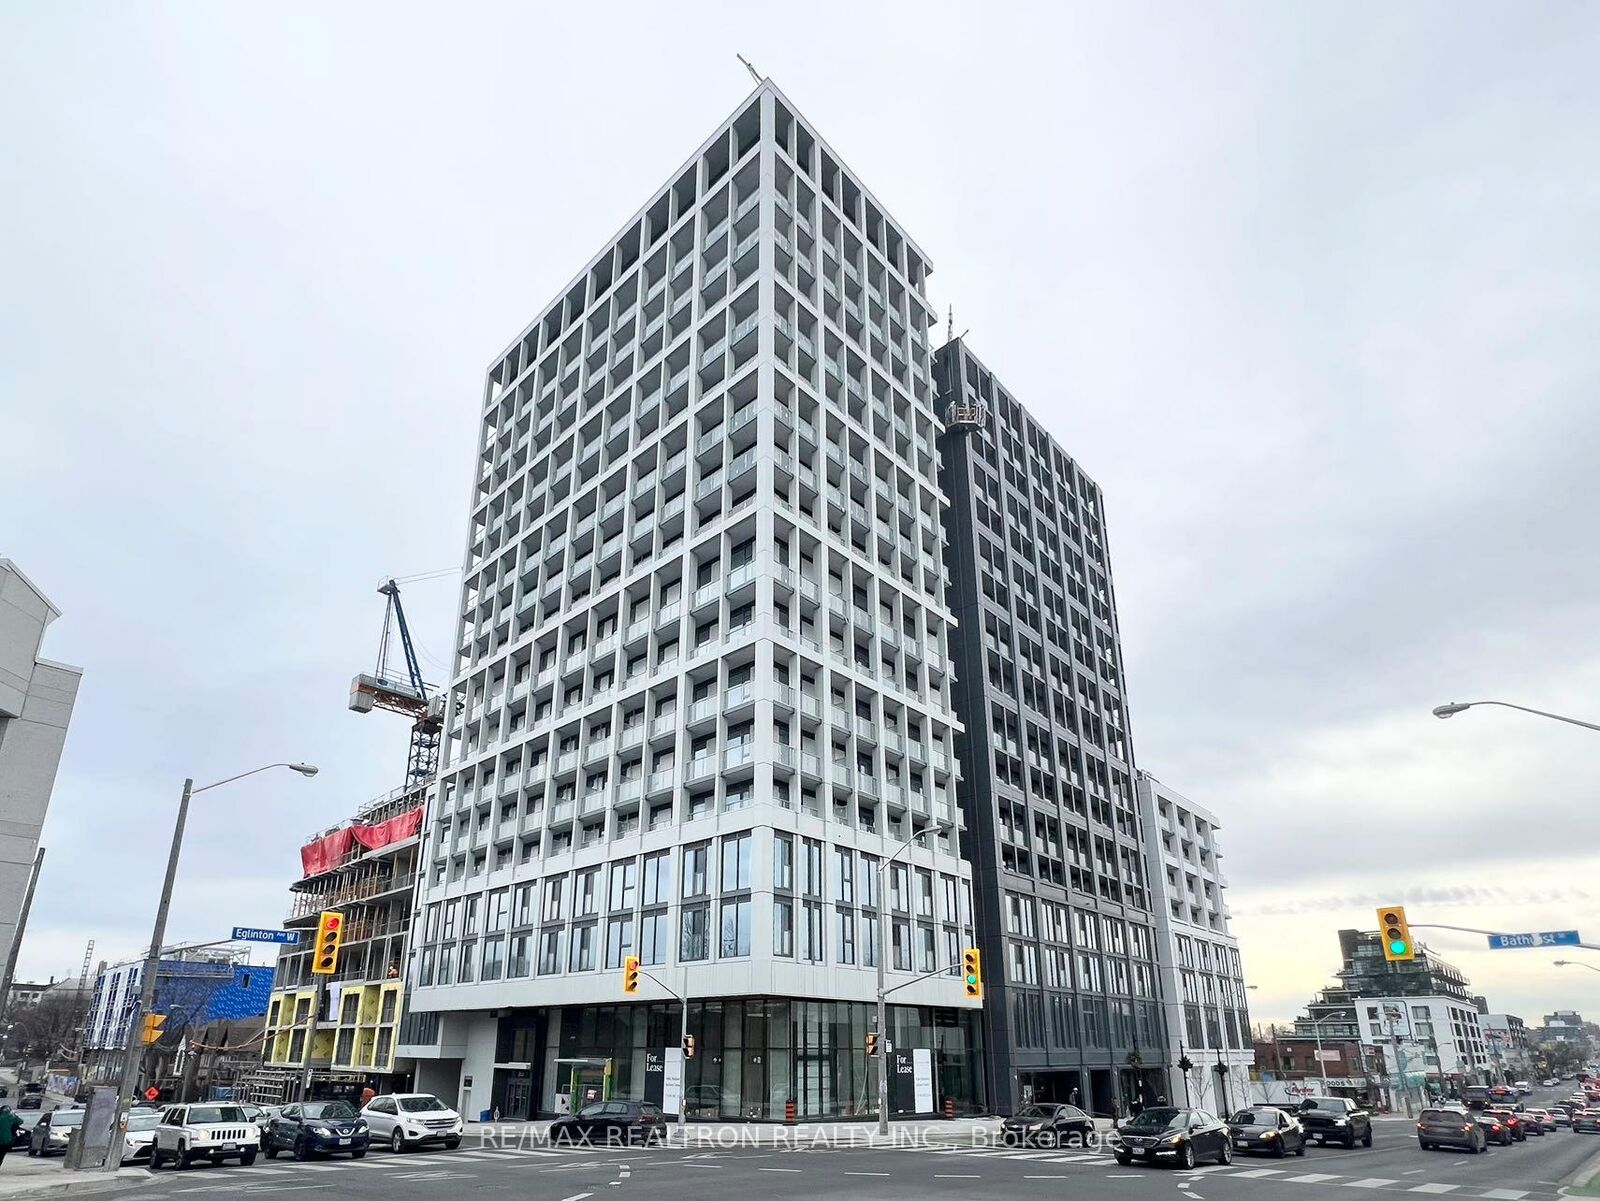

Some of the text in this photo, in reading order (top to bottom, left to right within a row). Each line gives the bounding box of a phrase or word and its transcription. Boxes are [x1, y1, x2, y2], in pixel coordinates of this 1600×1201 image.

[235, 928, 274, 940] Eglinton
[286, 932, 295, 941] W
[1500, 934, 1556, 946] Bathust
[646, 1053, 657, 1063] For
[896, 1054, 907, 1064] For
[646, 1062, 663, 1072] Lease
